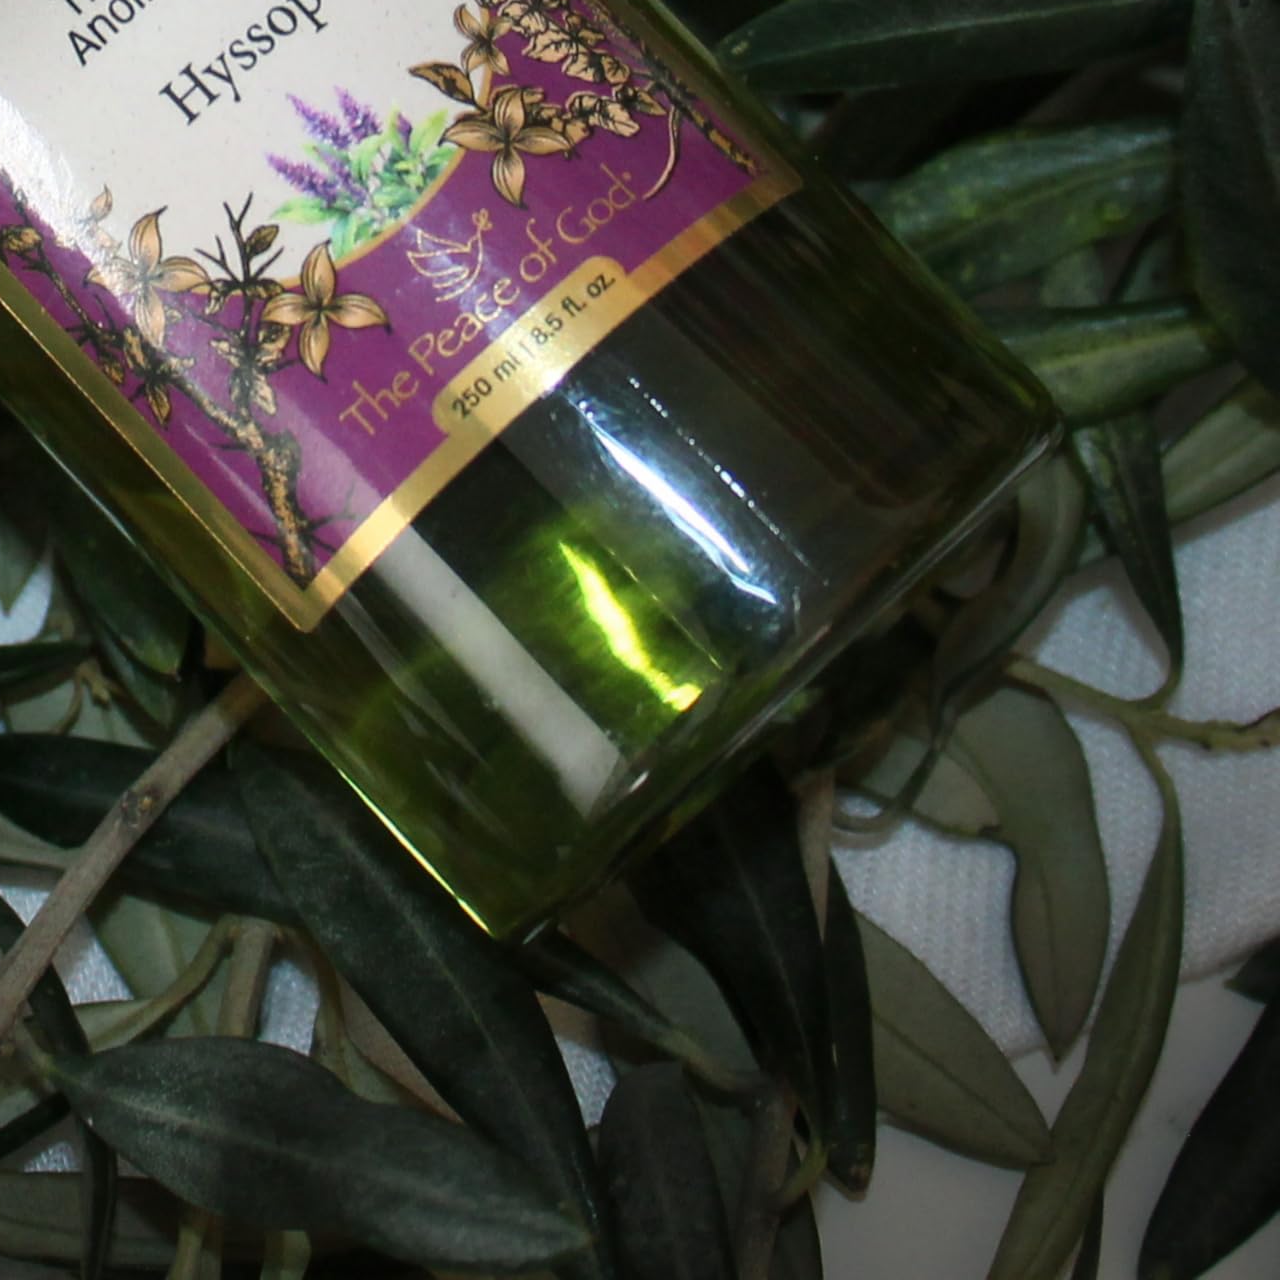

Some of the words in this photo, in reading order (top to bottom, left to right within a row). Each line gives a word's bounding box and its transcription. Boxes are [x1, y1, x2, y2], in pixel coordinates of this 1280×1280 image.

[338, 370, 419, 436] The
[408, 277, 521, 376] Peace
[519, 217, 557, 283] of
[452, 377, 492, 417] 250
[494, 351, 521, 382] ml
[531, 313, 563, 345] 8.5
[561, 296, 587, 317] fl.
